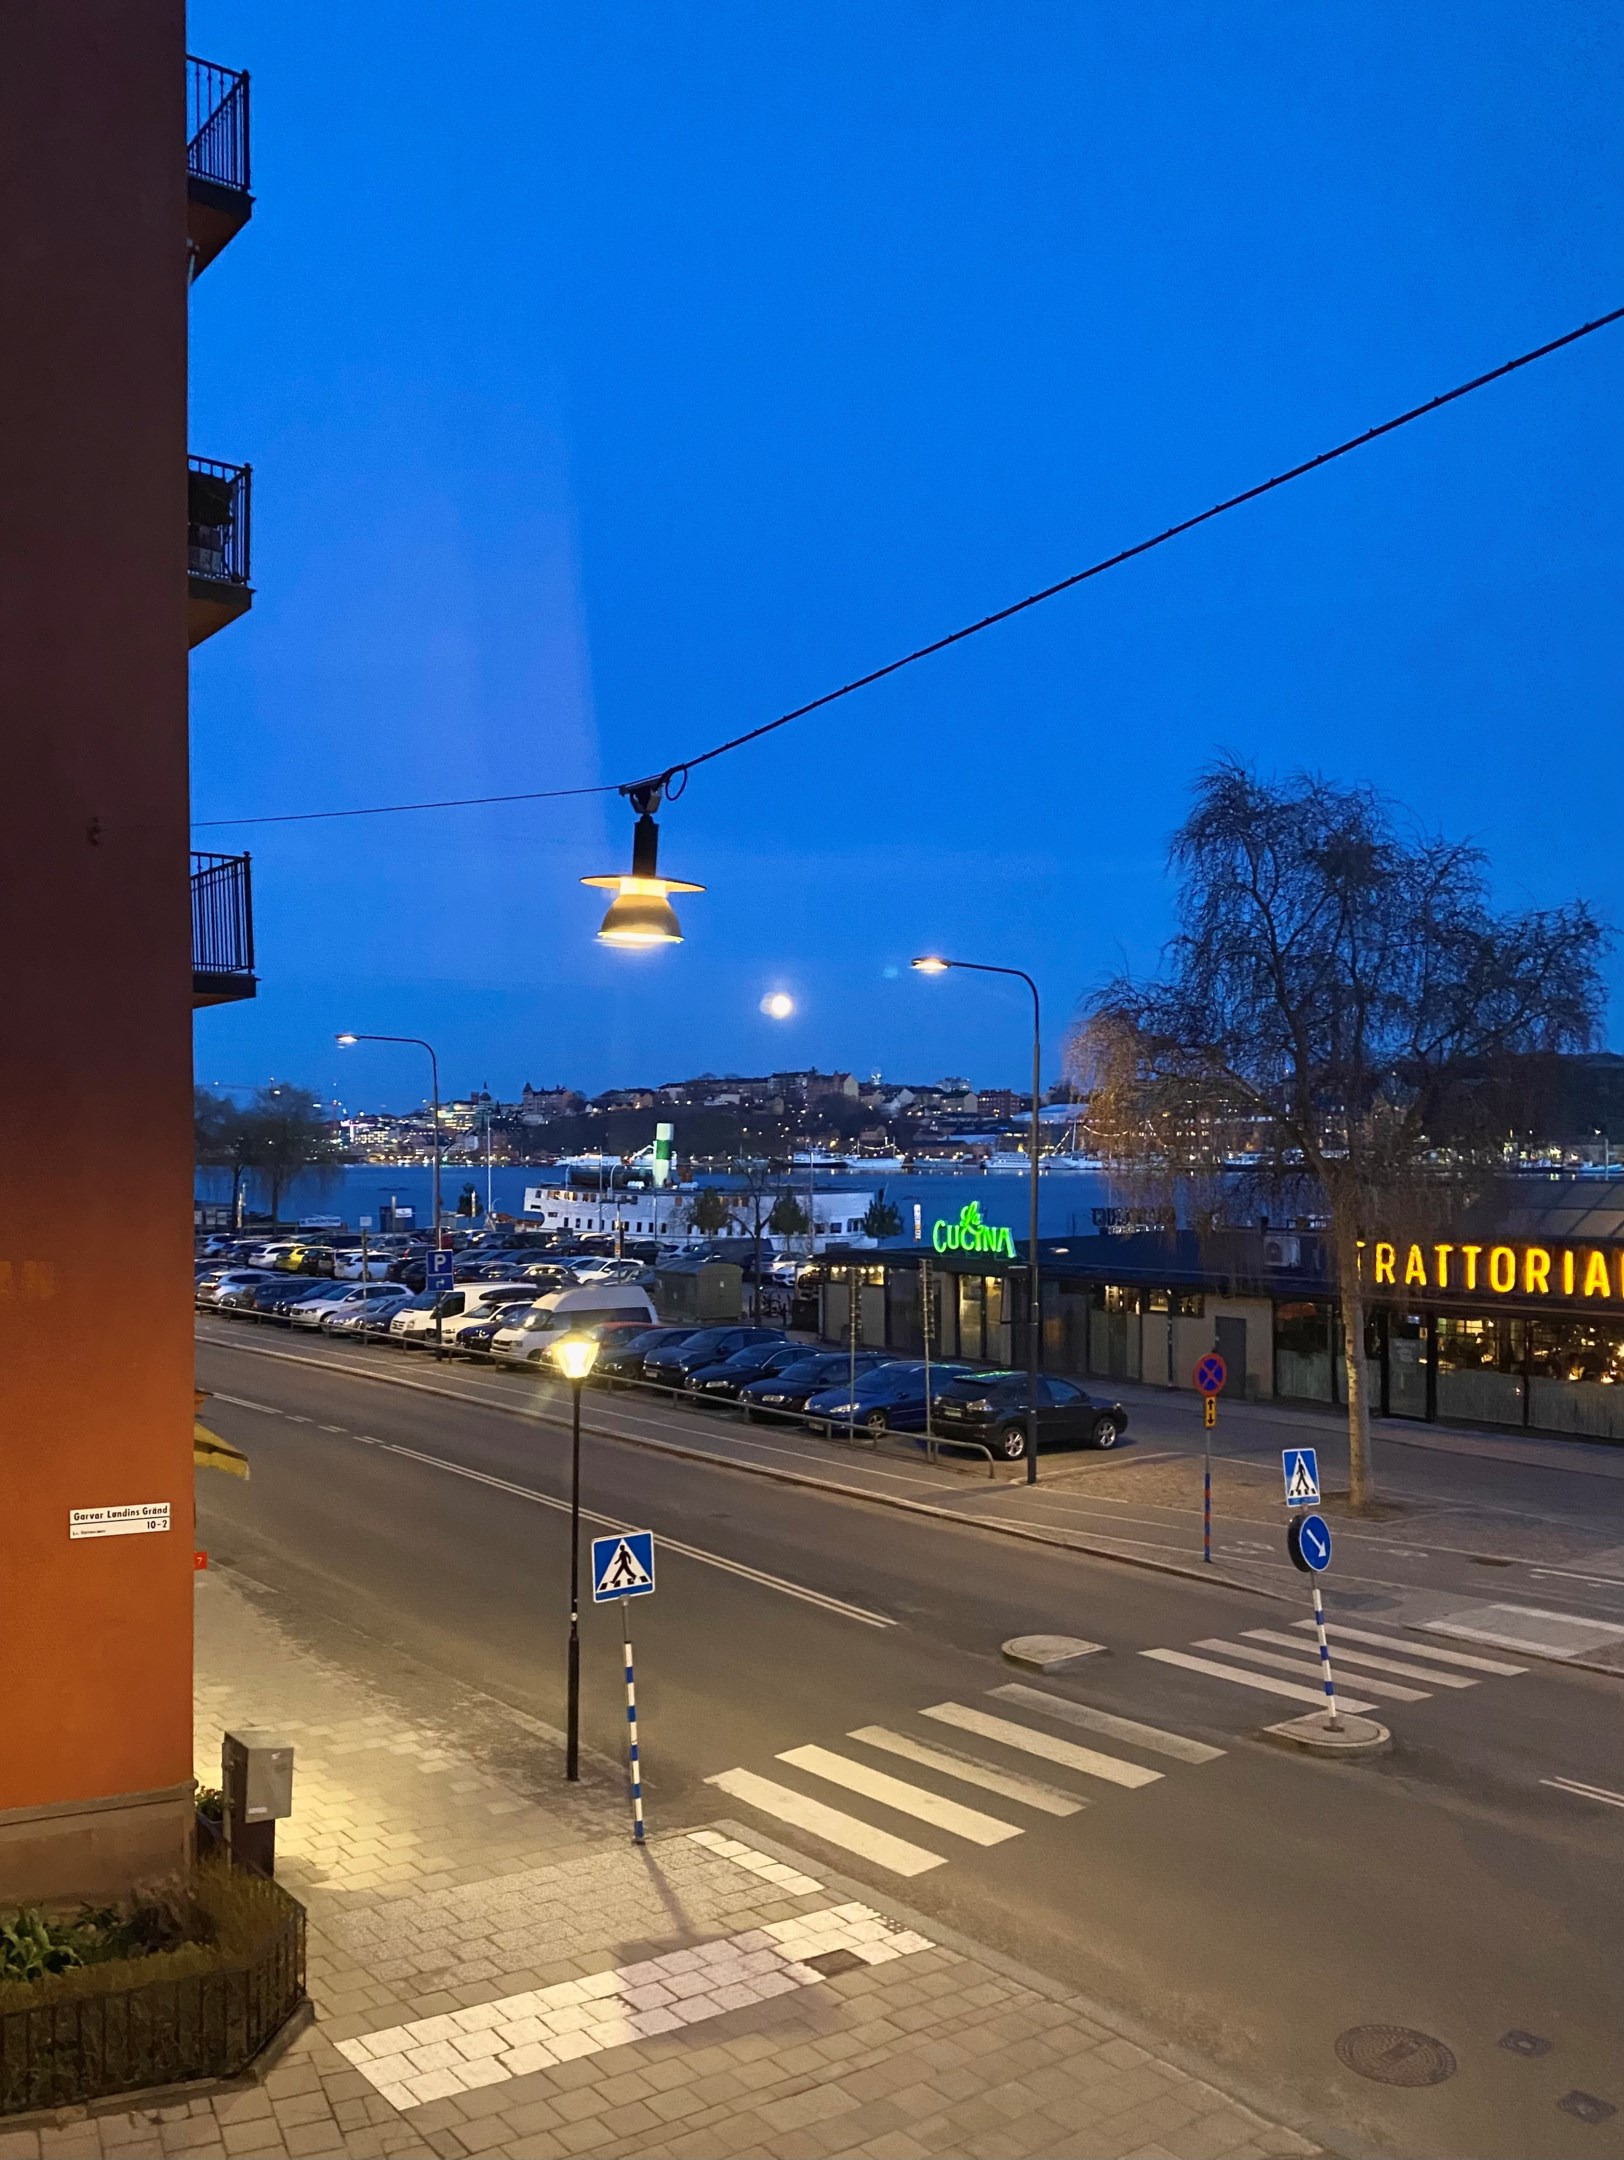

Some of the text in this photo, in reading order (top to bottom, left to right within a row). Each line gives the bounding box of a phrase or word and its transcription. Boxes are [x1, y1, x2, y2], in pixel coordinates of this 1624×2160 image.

[932, 1219, 1016, 1258] CUCINA
[433, 1253, 447, 1272] P
[146, 1519, 168, 1530] 10-2
